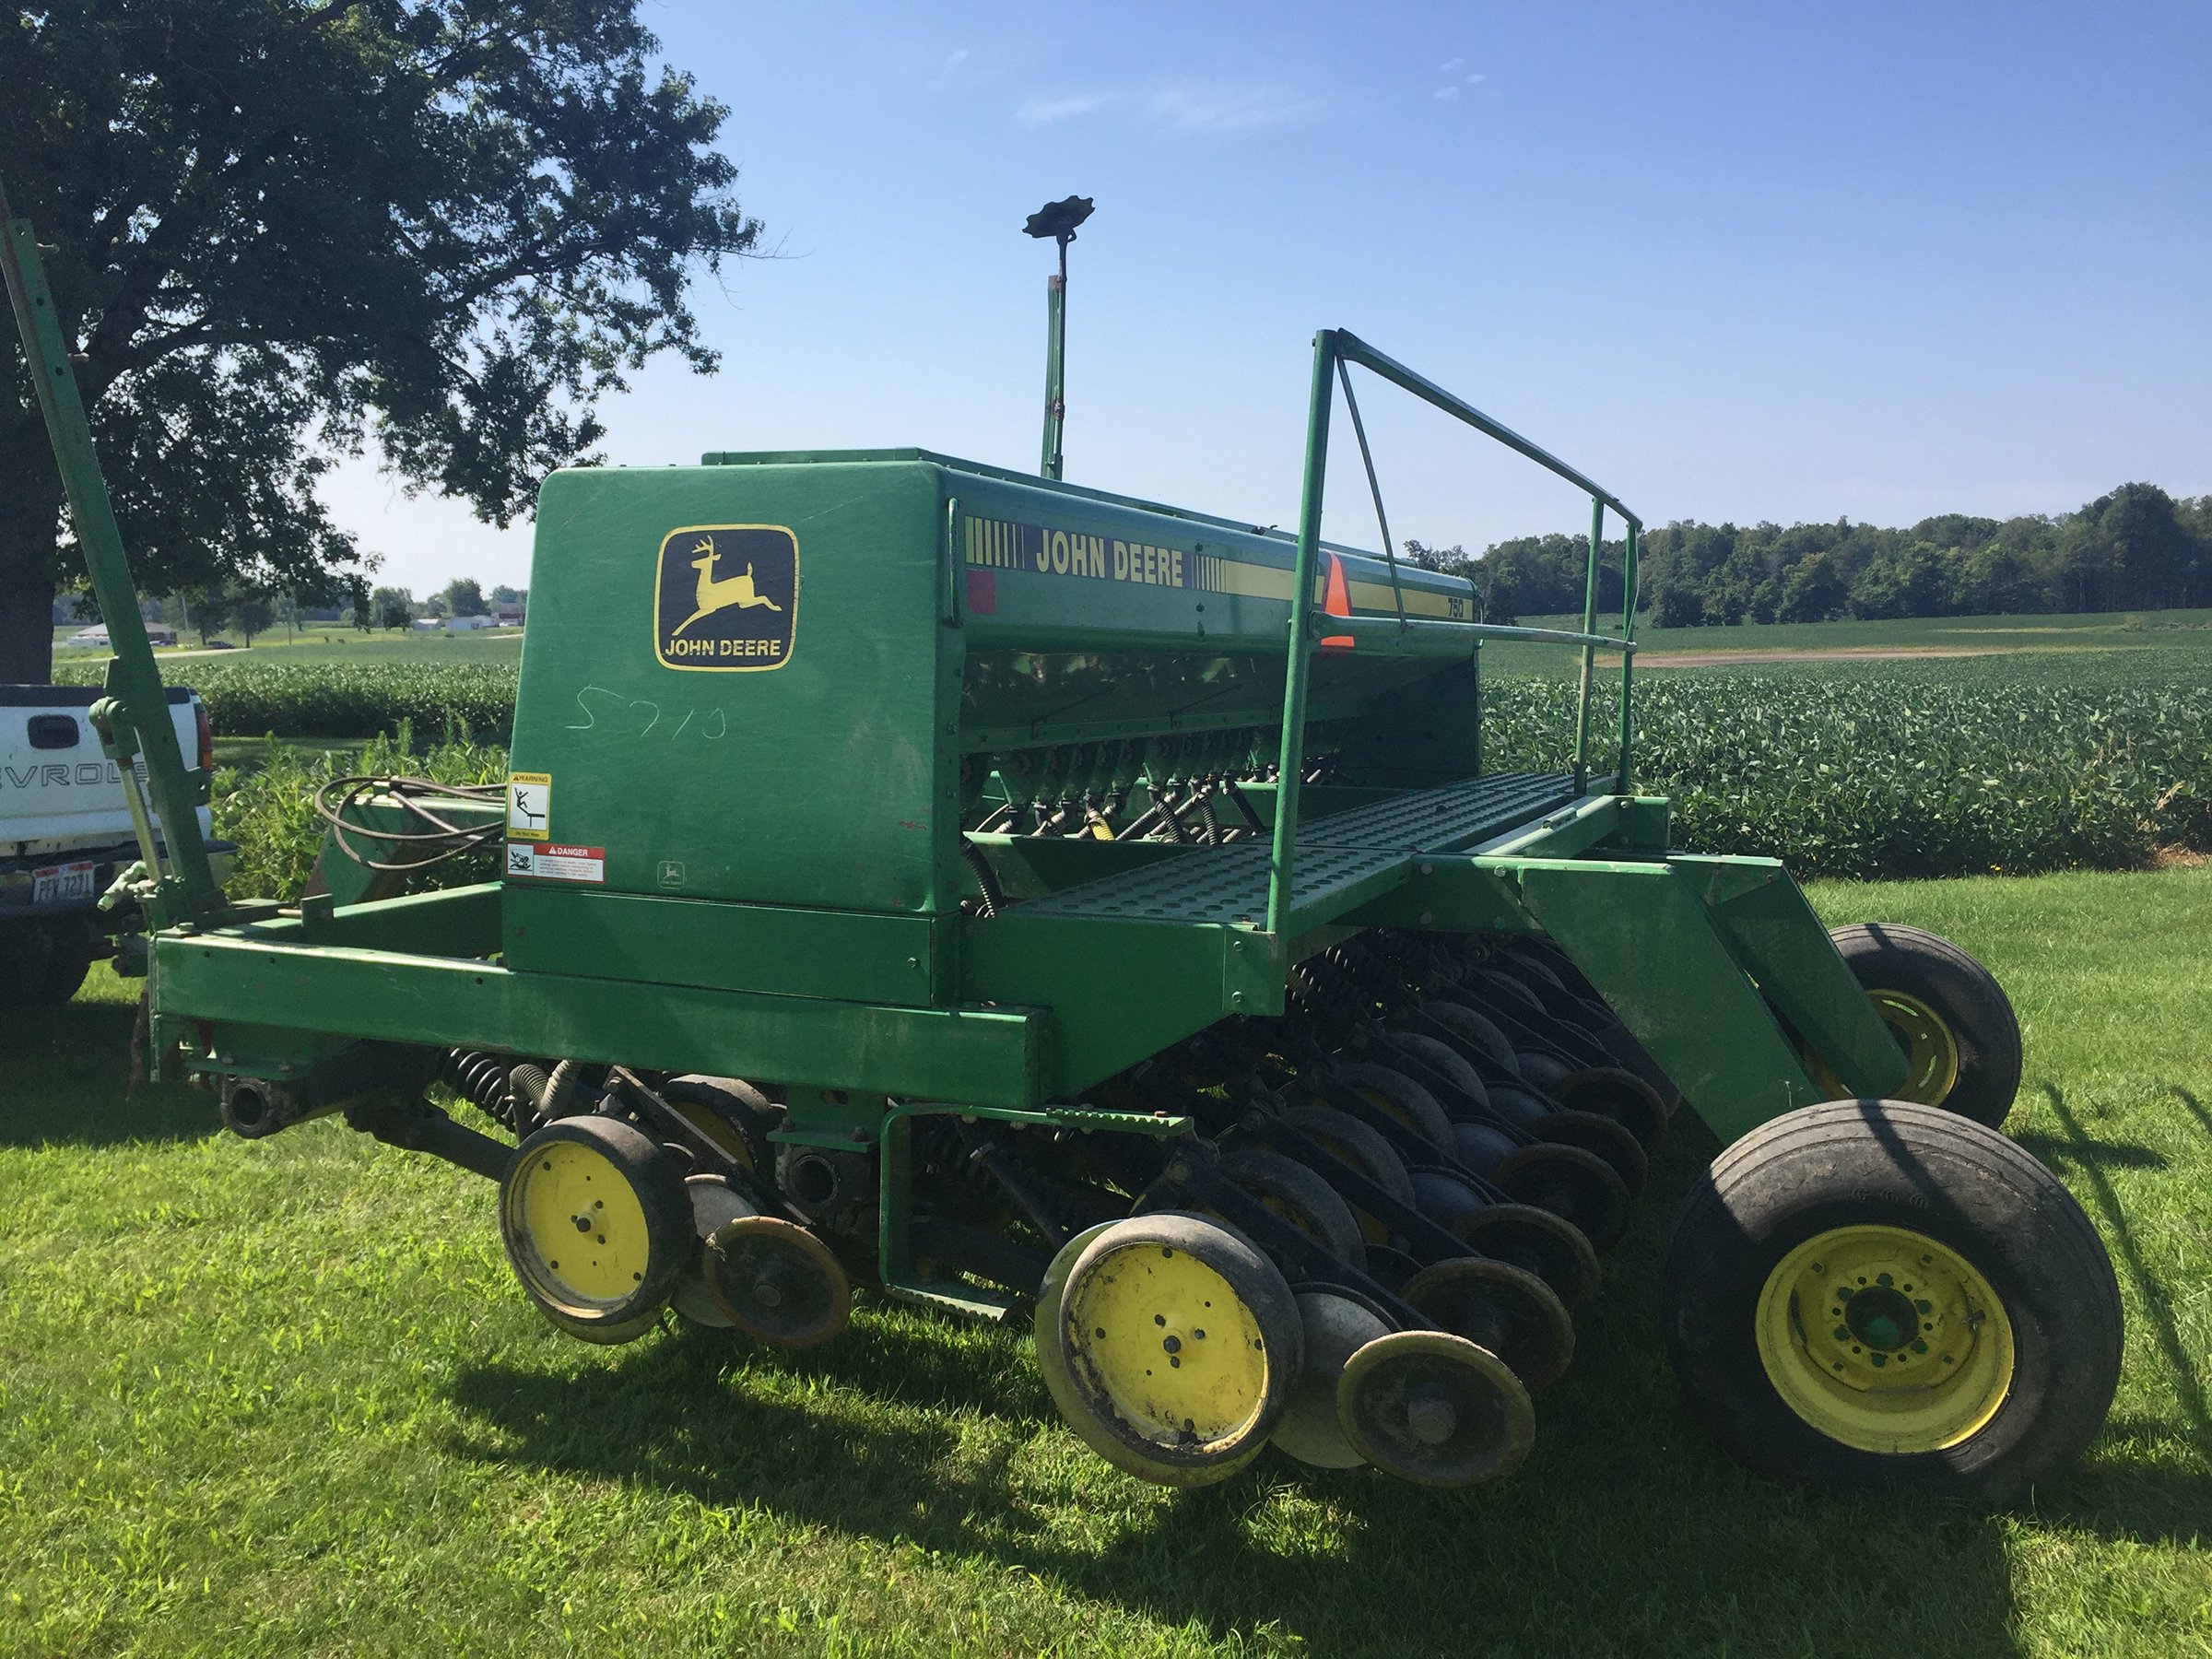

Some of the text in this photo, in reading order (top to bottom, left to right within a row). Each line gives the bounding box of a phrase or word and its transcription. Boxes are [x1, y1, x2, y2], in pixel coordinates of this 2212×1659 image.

[1036, 529, 1183, 588] JOHN DEERE
[1448, 597, 1464, 618] 750
[665, 639, 782, 656] JOHN DEERE
[519, 774, 548, 783] WARNING
[557, 847, 588, 856] DANGER
